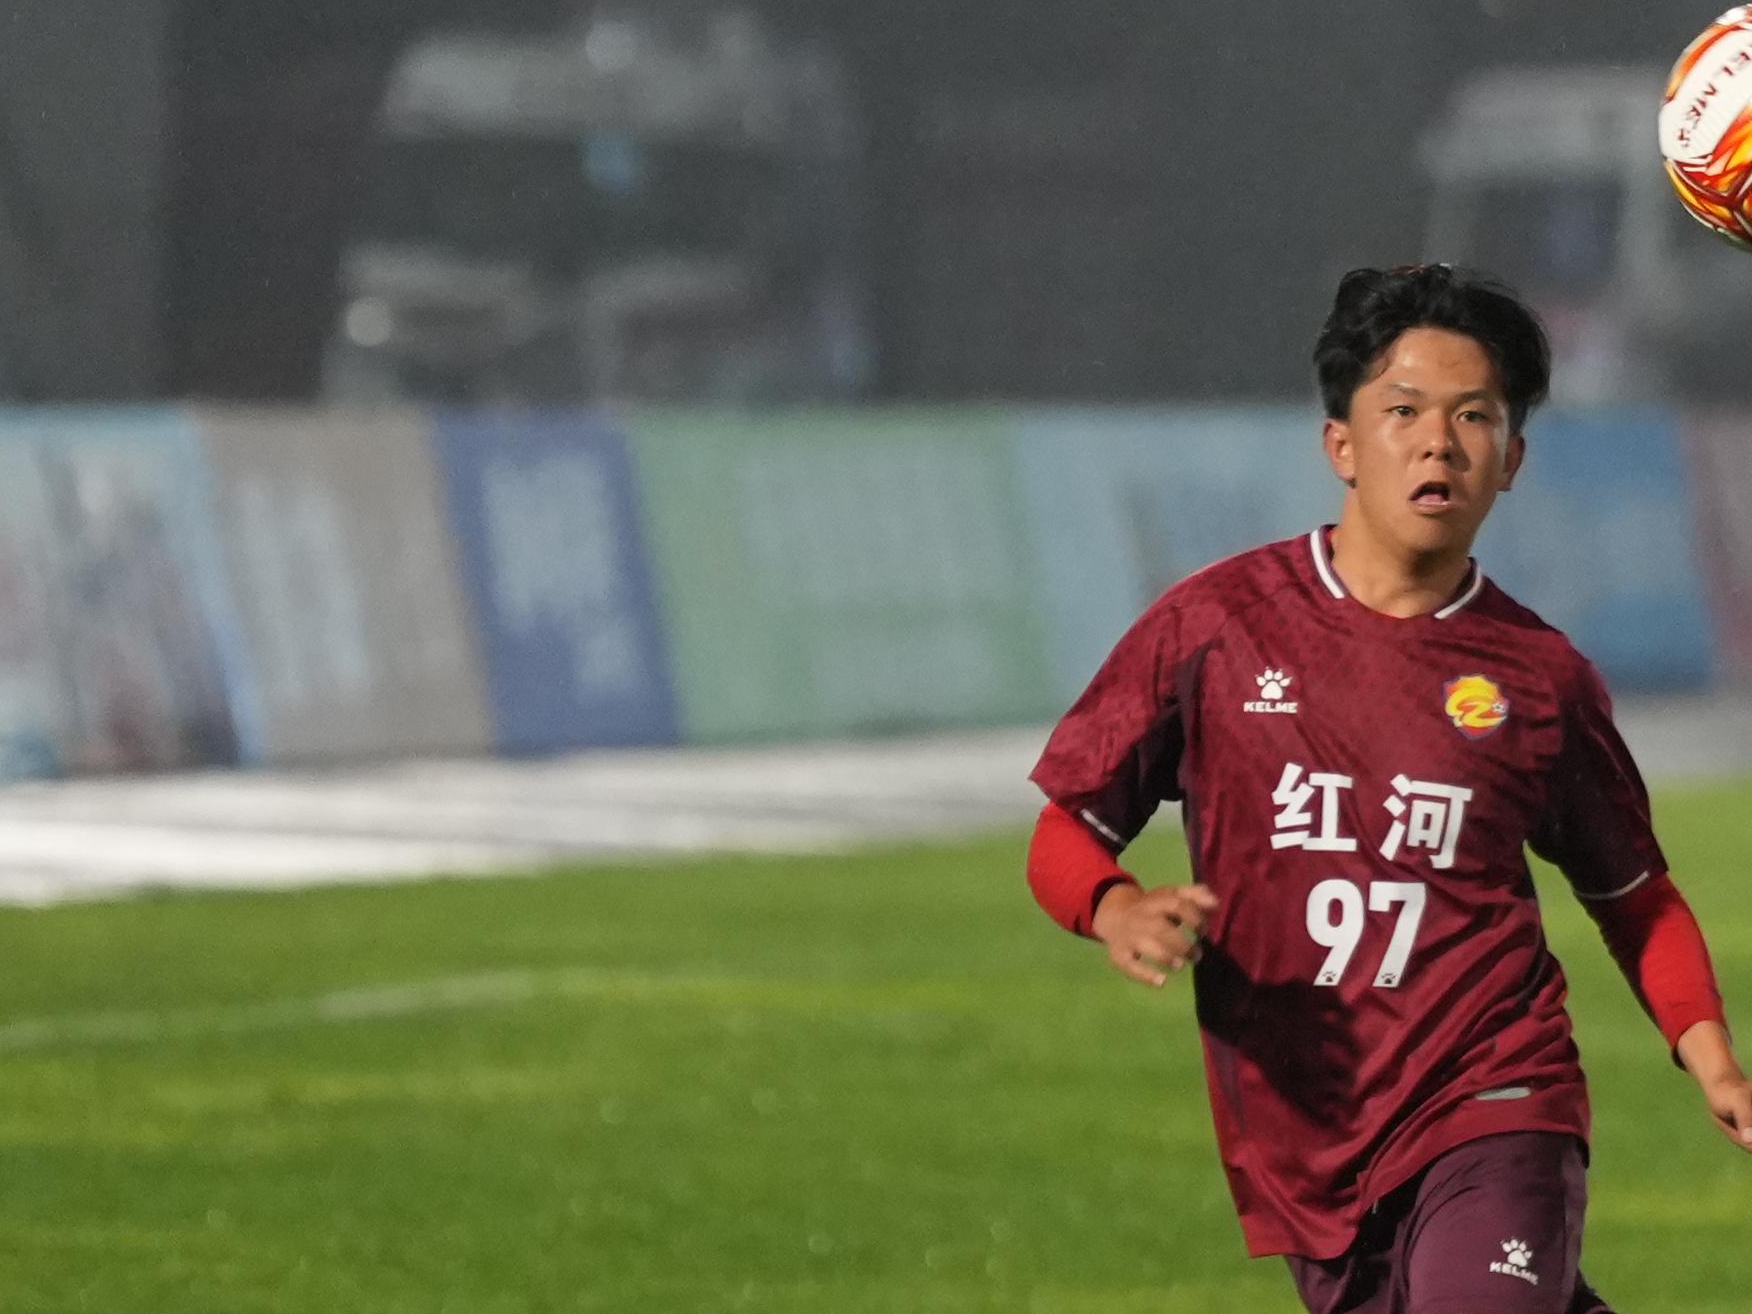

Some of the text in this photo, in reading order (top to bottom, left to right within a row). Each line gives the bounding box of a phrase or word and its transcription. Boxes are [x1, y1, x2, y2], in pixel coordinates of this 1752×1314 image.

[1243, 701, 1298, 714] KELME
[1270, 762, 1473, 869] 红河
[1306, 879, 1427, 988] 97
[1489, 1261, 1538, 1285] KELME
